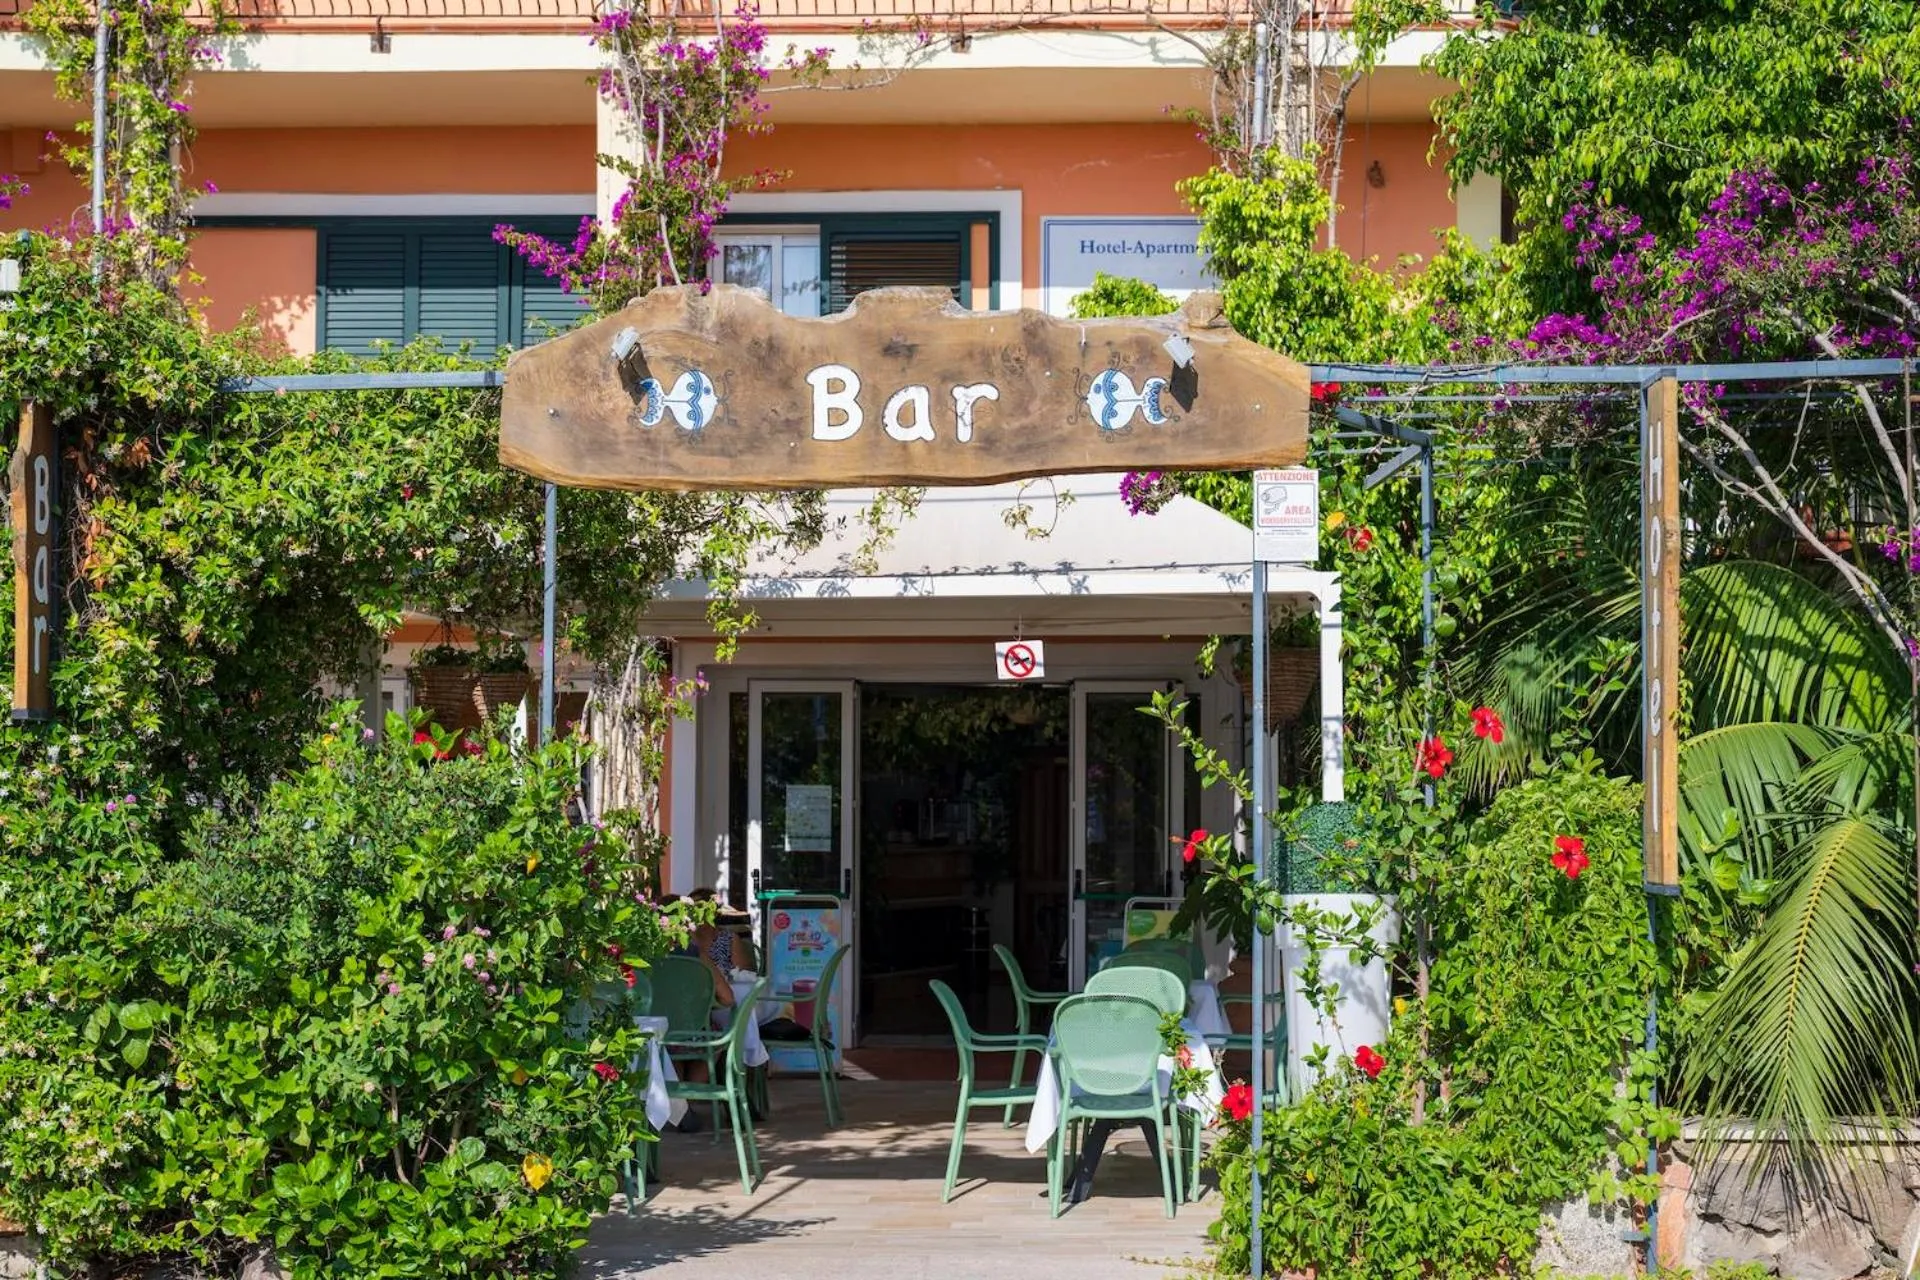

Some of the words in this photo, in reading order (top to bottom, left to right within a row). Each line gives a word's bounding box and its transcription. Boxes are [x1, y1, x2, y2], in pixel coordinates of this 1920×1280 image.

[805, 364, 999, 443] Bar
[1256, 471, 1315, 481] ATTENZIONE
[1285, 505, 1311, 515] AREA
[34, 454, 50, 674] Bar
[1648, 420, 1662, 833] Hotel
